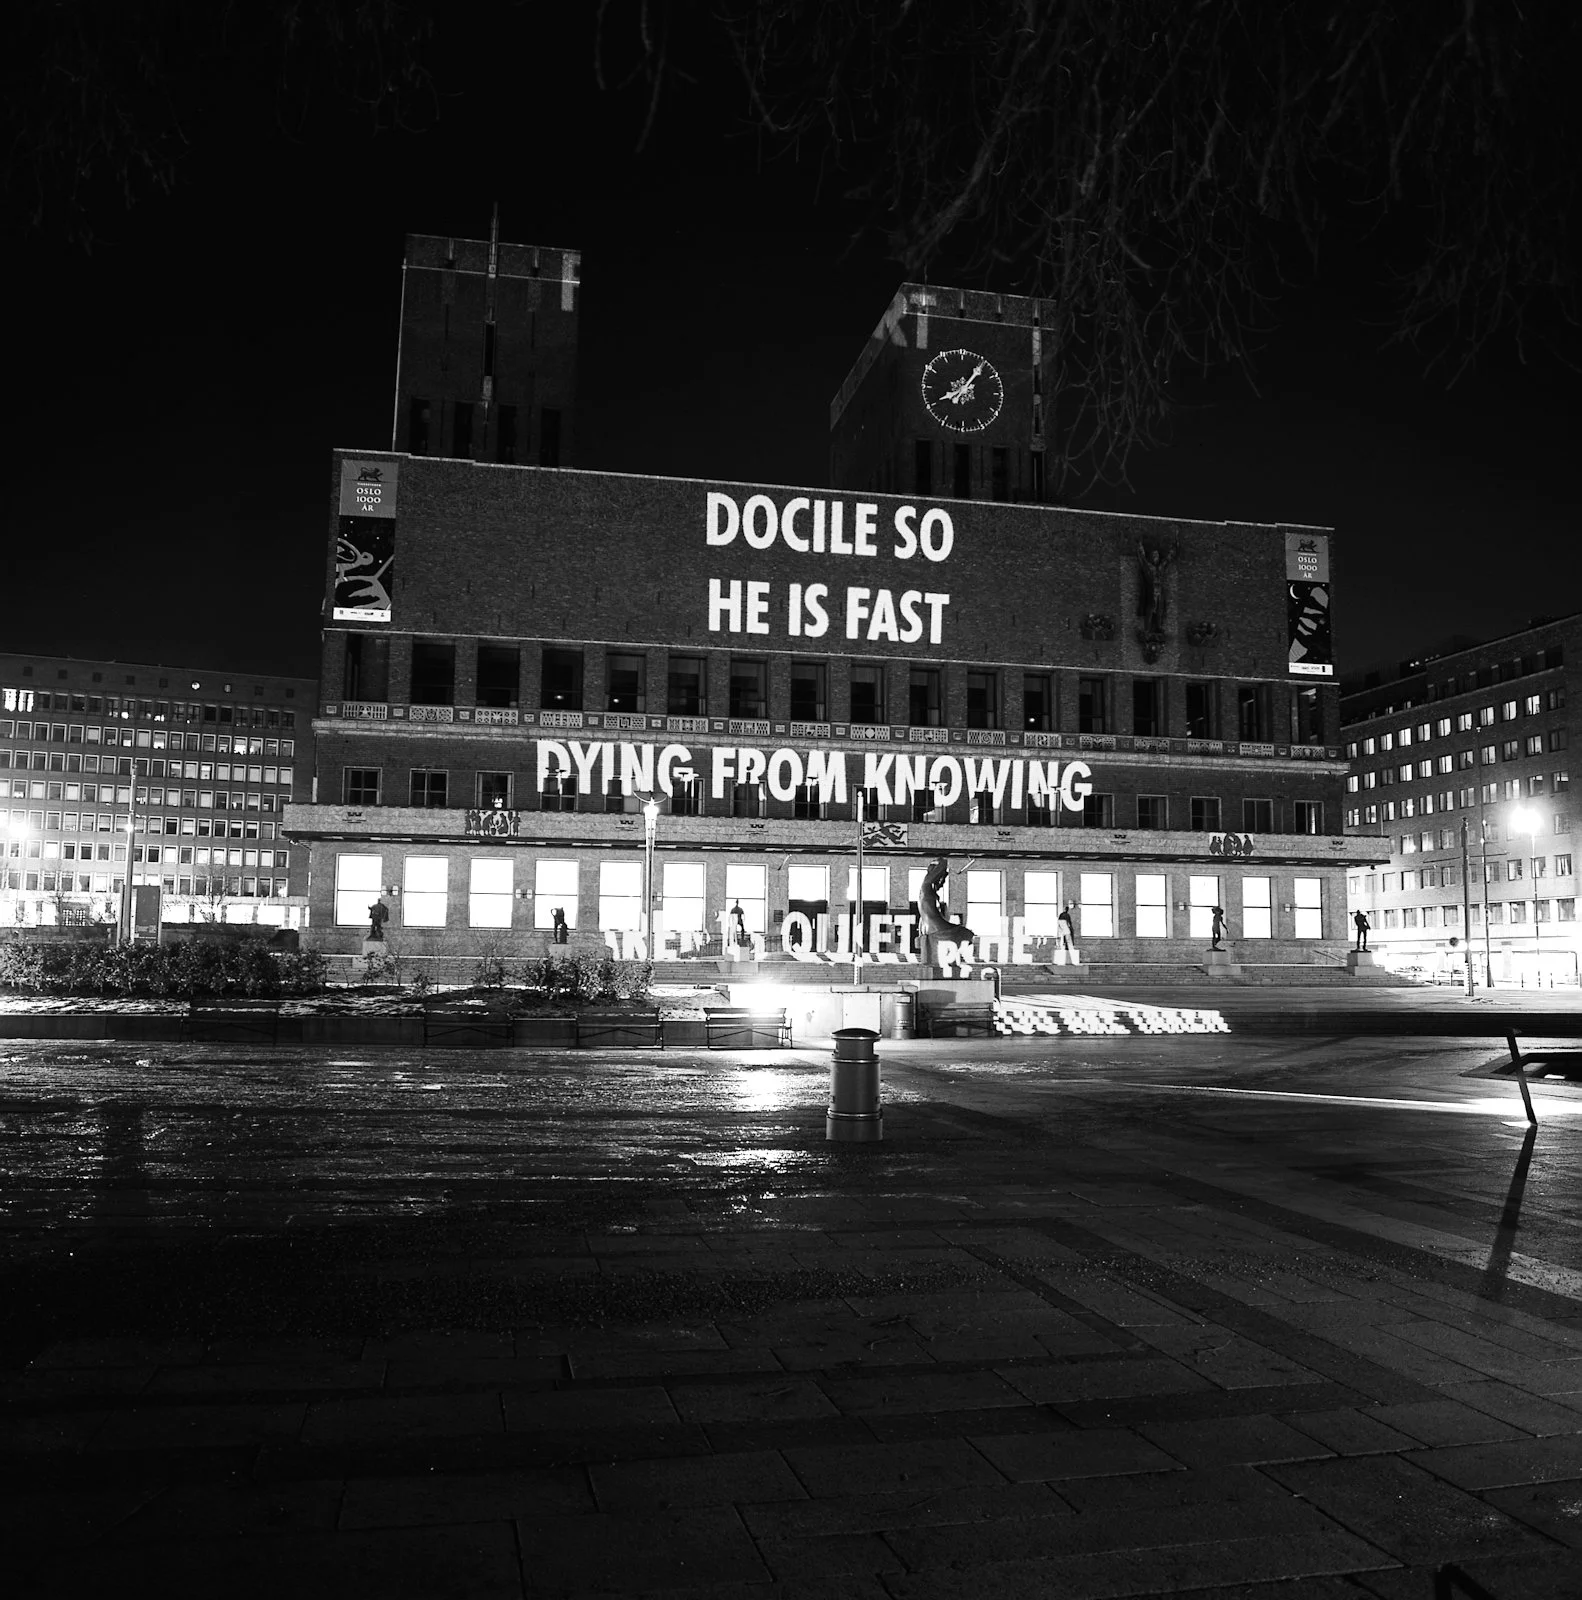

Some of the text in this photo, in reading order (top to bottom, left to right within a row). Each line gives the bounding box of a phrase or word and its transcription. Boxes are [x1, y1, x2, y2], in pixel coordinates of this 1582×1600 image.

[706, 491, 955, 562] DOCILE SO
[708, 578, 950, 644] HE IS FAST
[536, 739, 1093, 812] DYING FROM KNOWING
